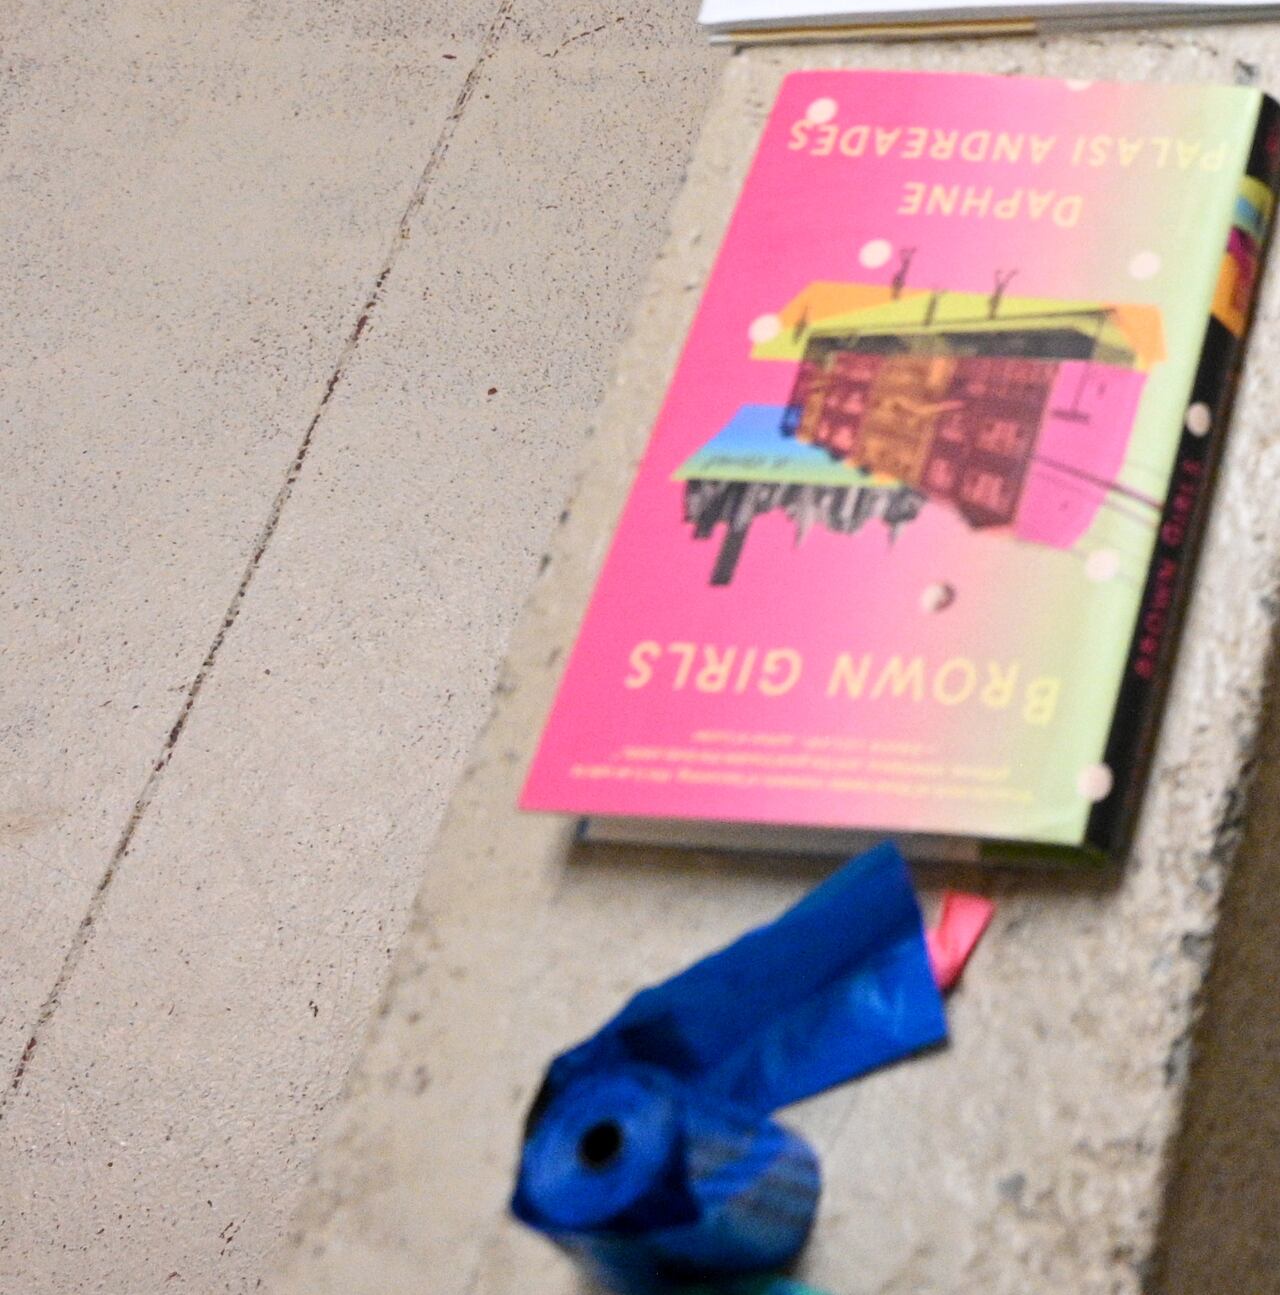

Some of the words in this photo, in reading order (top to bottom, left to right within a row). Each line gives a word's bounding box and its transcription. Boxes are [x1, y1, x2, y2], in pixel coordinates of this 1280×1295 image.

[786, 118, 1056, 164] ANDREADES
[1072, 134, 1230, 171] PALASI
[896, 181, 1084, 228] DAPHNE
[624, 640, 803, 697] GIRLS
[824, 651, 1061, 727] BROWN
